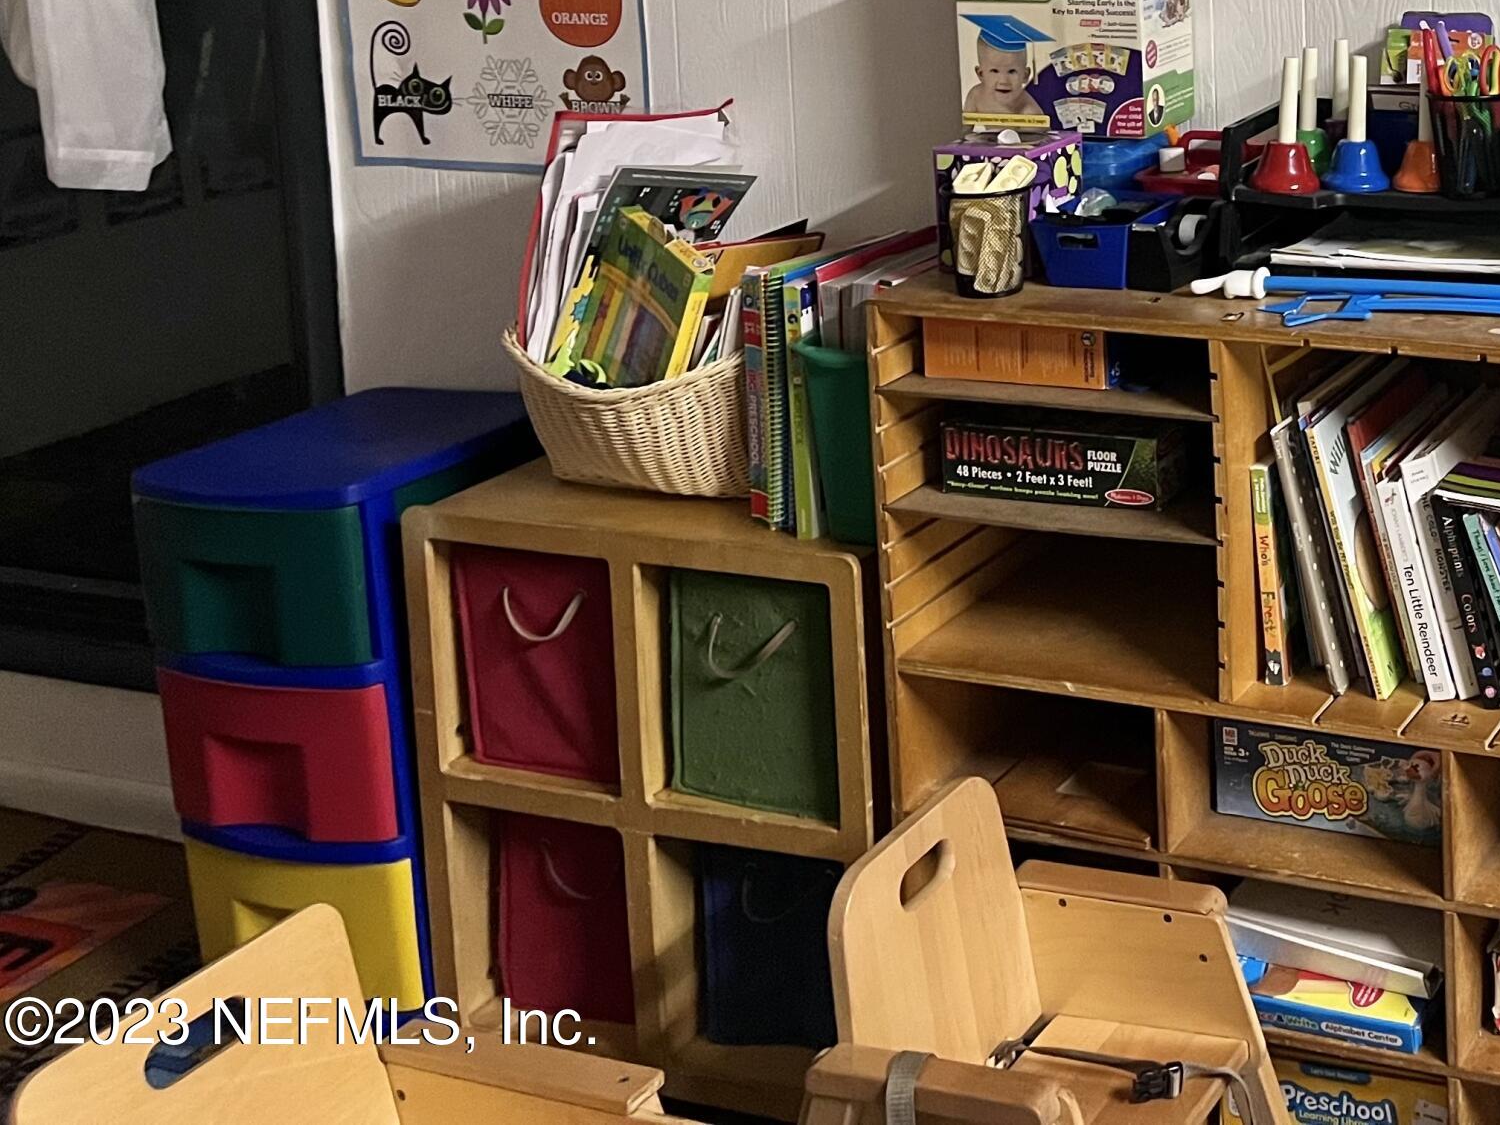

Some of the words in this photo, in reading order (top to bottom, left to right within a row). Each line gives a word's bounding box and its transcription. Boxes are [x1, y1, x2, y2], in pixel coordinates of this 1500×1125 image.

[1068, 0, 1095, 7] Starting
[1097, 0, 1115, 7] Early
[1075, 8, 1104, 16] Reading
[551, 12, 609, 26] ORANGE
[377, 94, 422, 108] BLACK
[488, 94, 534, 109] WHITE
[571, 99, 622, 114] BROWN
[749, 394, 760, 465] PRESCHOOL
[945, 427, 1084, 471] DINOSAURS
[1087, 449, 1117, 462] FLOOR
[956, 465, 970, 477] 48
[971, 465, 1002, 480] Pieces
[1016, 471, 1023, 483] 2
[1025, 473, 1047, 485] Feet
[1049, 476, 1055, 485] x
[1057, 475, 1065, 486] 3
[1067, 475, 1093, 488] Feet!
[1087, 461, 1122, 474] PUZZLE
[1434, 548, 1451, 594] MONSTER
[1403, 564, 1414, 586] Ten
[1409, 589, 1424, 619] Little
[1418, 622, 1438, 677] Reindeer
[1462, 594, 1477, 633] Colors
[1263, 742, 1327, 768] Duck
[1285, 763, 1350, 786] Duck
[1257, 770, 1366, 817] Goose
[1285, 1015, 1318, 1030] Write
[1325, 1023, 1365, 1038] Alphabet
[1368, 1032, 1398, 1044] Center
[1281, 1084, 1393, 1125] Preschool
